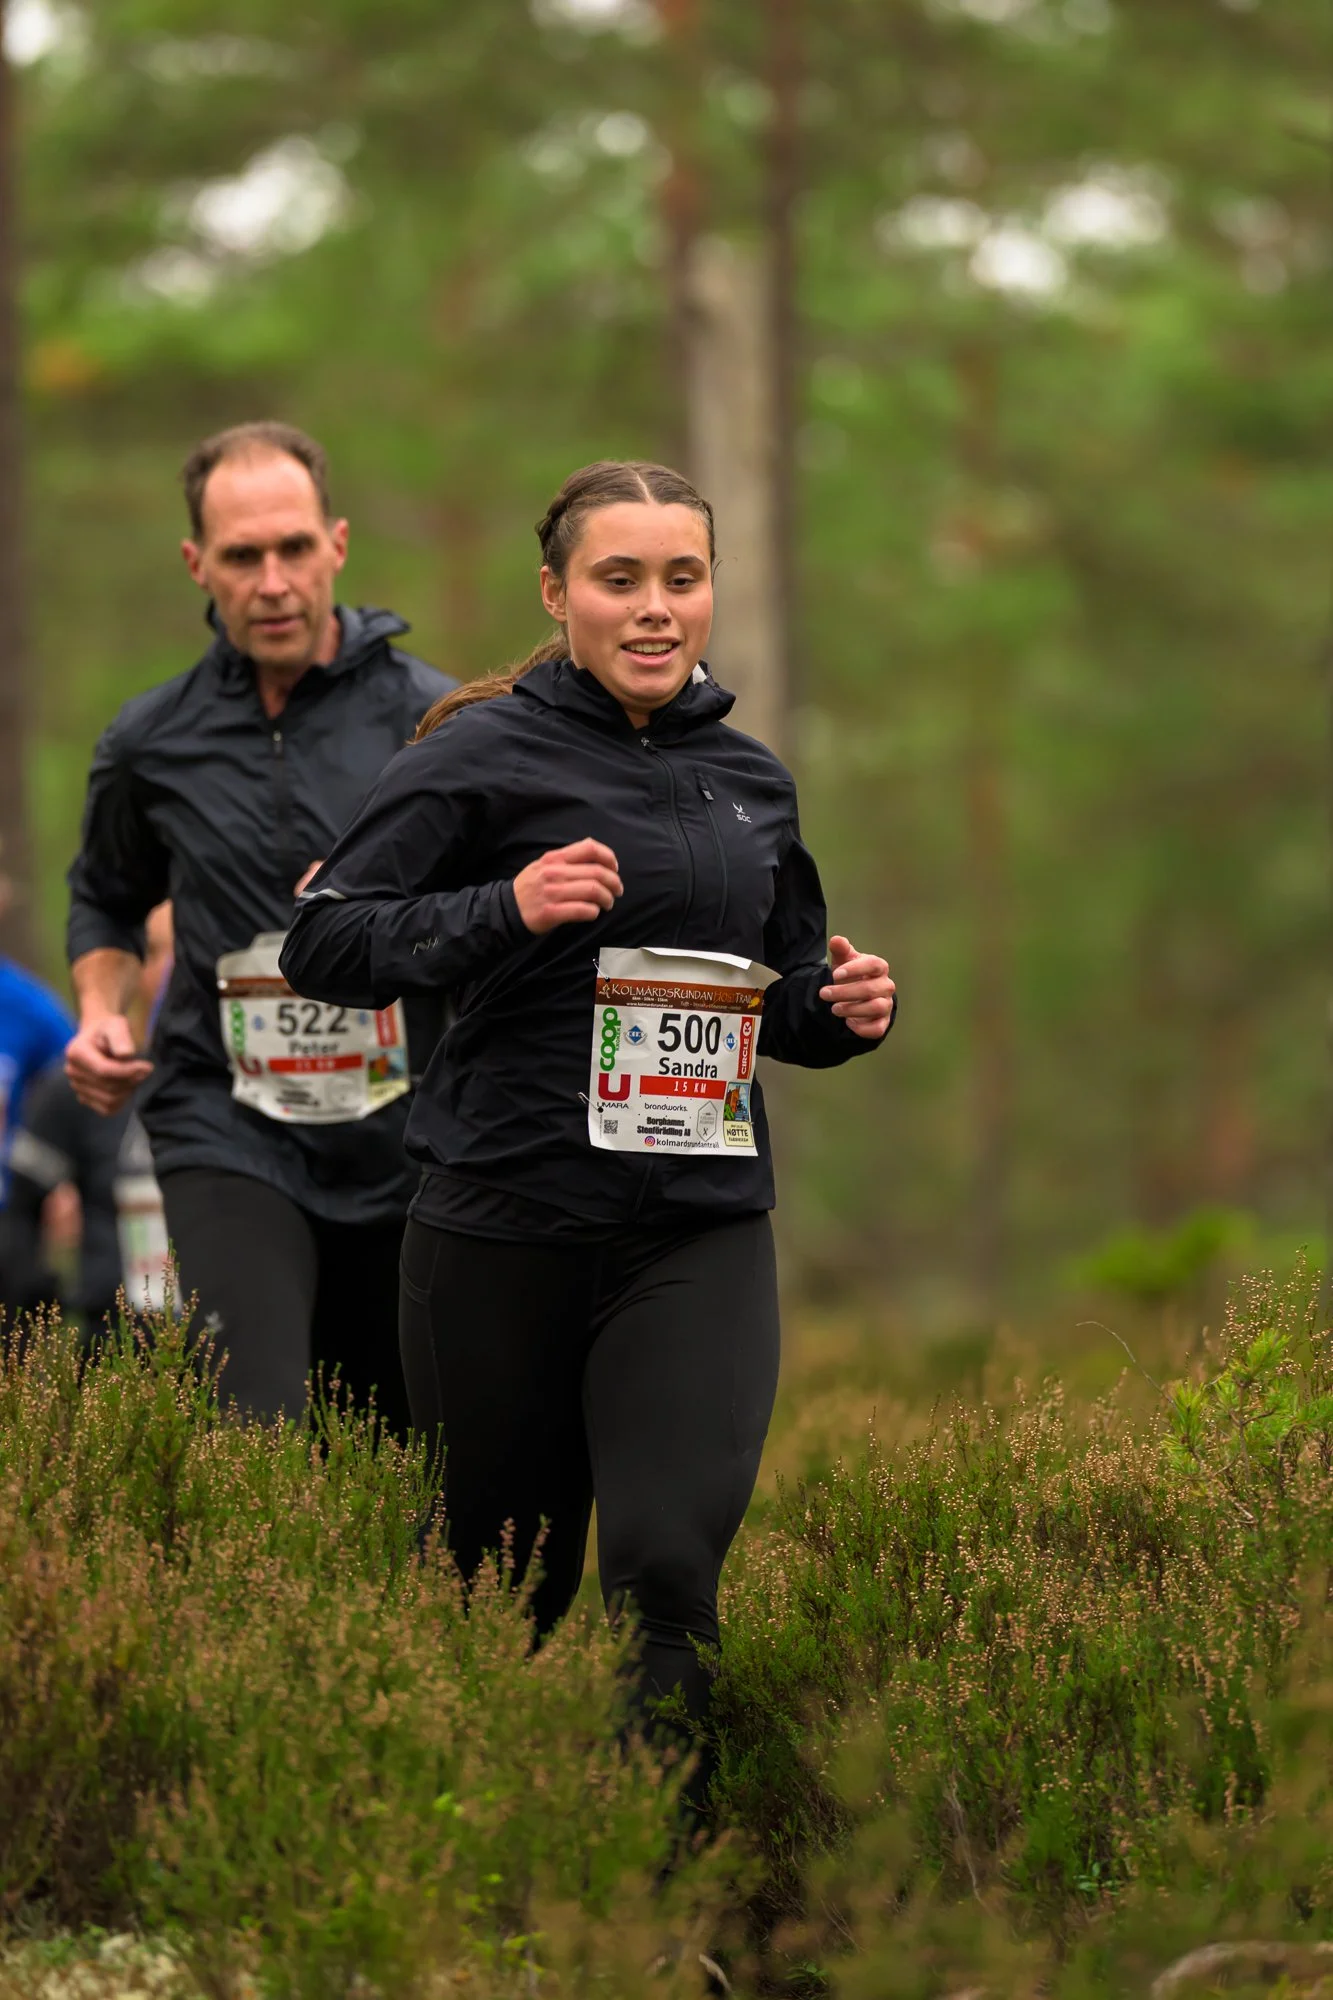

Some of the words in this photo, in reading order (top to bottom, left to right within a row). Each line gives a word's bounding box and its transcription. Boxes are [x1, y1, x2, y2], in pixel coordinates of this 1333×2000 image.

[277, 1003, 349, 1036] 522
[657, 1012, 722, 1055] 500
[288, 1040, 339, 1056] Peter
[600, 1007, 622, 1071] coop
[741, 1038, 750, 1075] CIRCLE
[658, 1057, 718, 1079] Sandra
